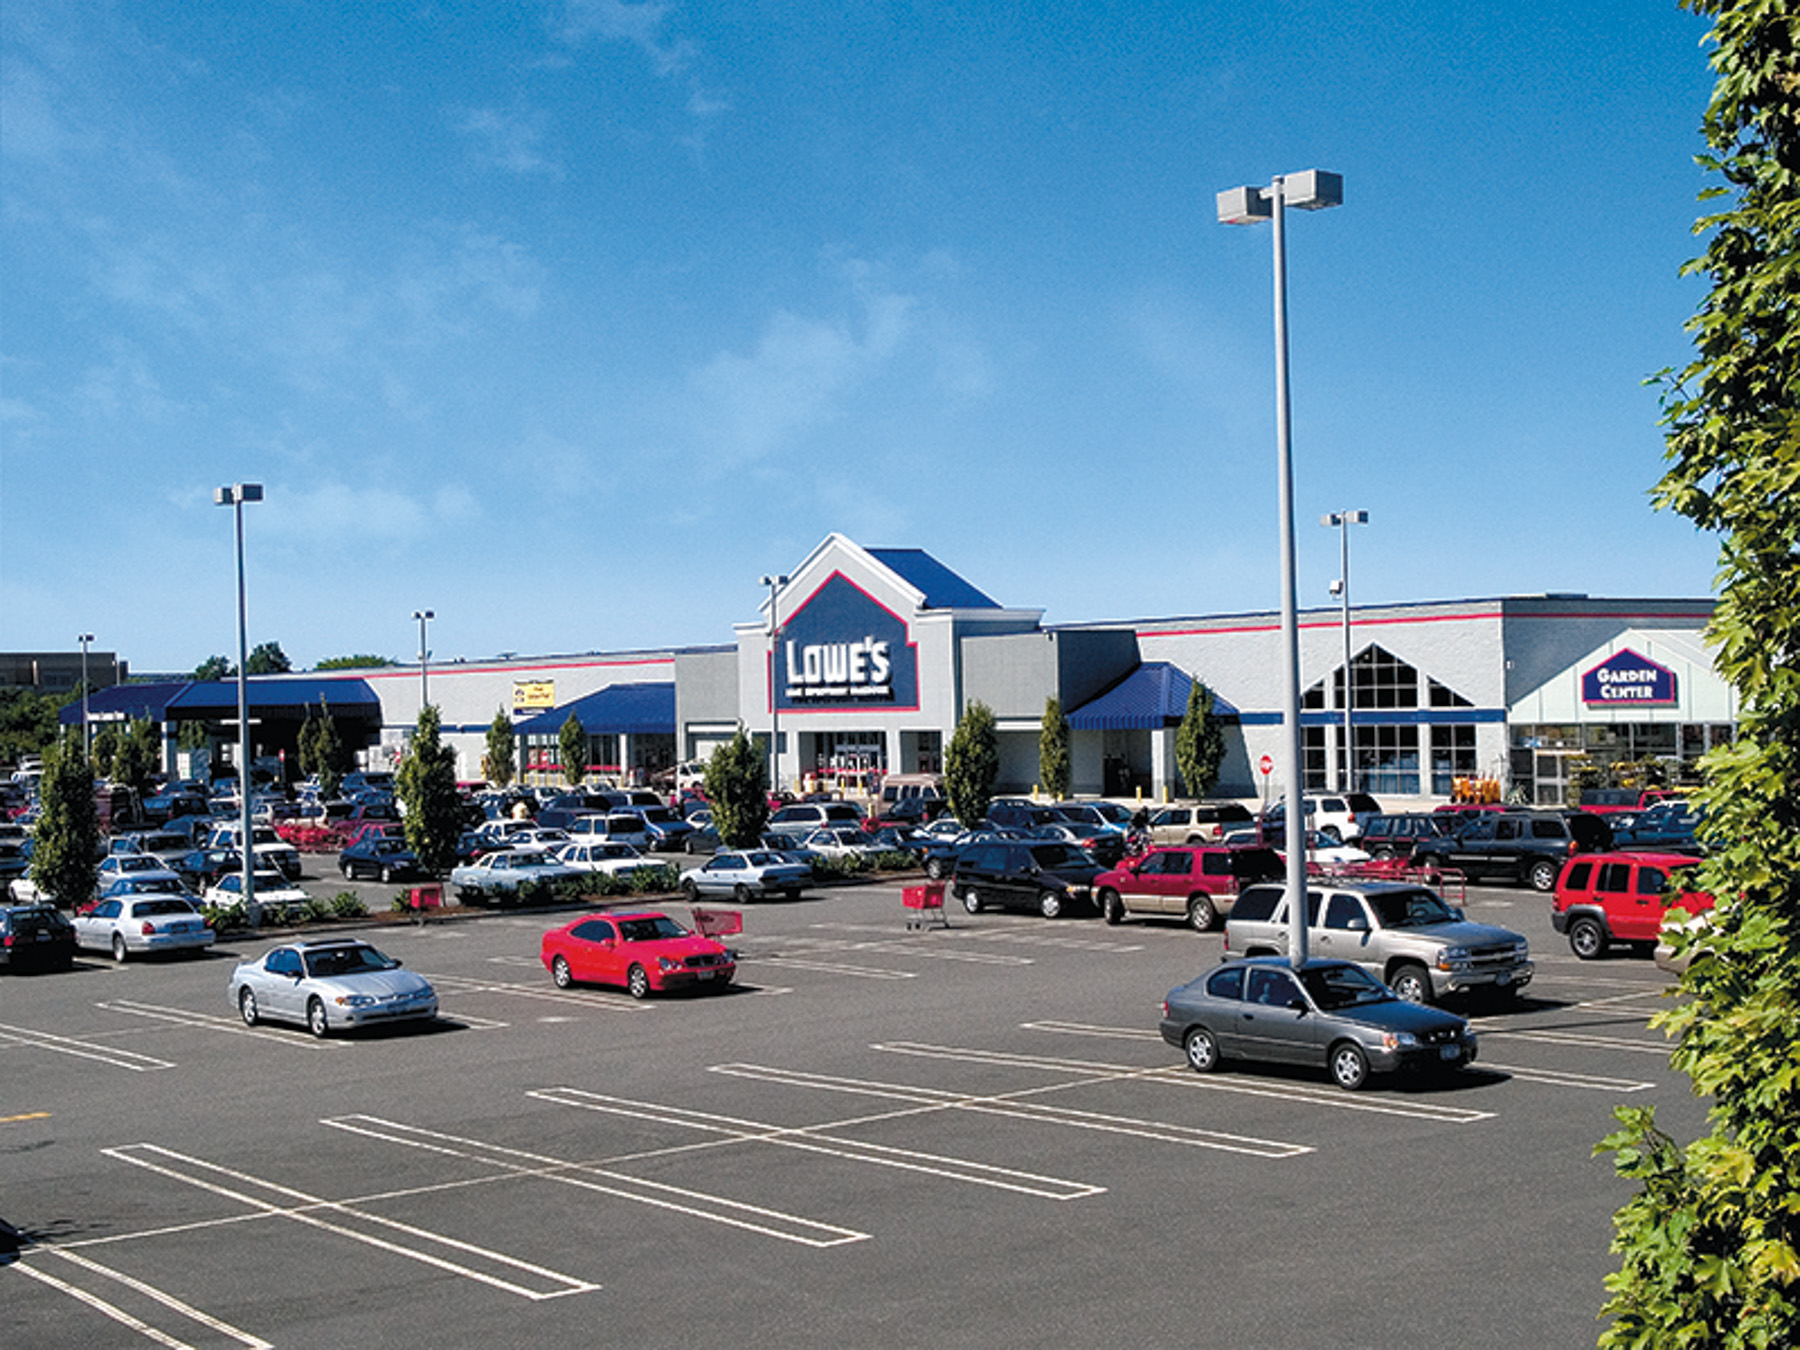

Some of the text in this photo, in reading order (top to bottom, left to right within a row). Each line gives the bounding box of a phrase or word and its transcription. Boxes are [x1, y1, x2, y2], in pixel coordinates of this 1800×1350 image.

[786, 635, 890, 684] LOWE'S
[1597, 667, 1657, 683] GARDEN
[1600, 683, 1653, 699] CENTER
